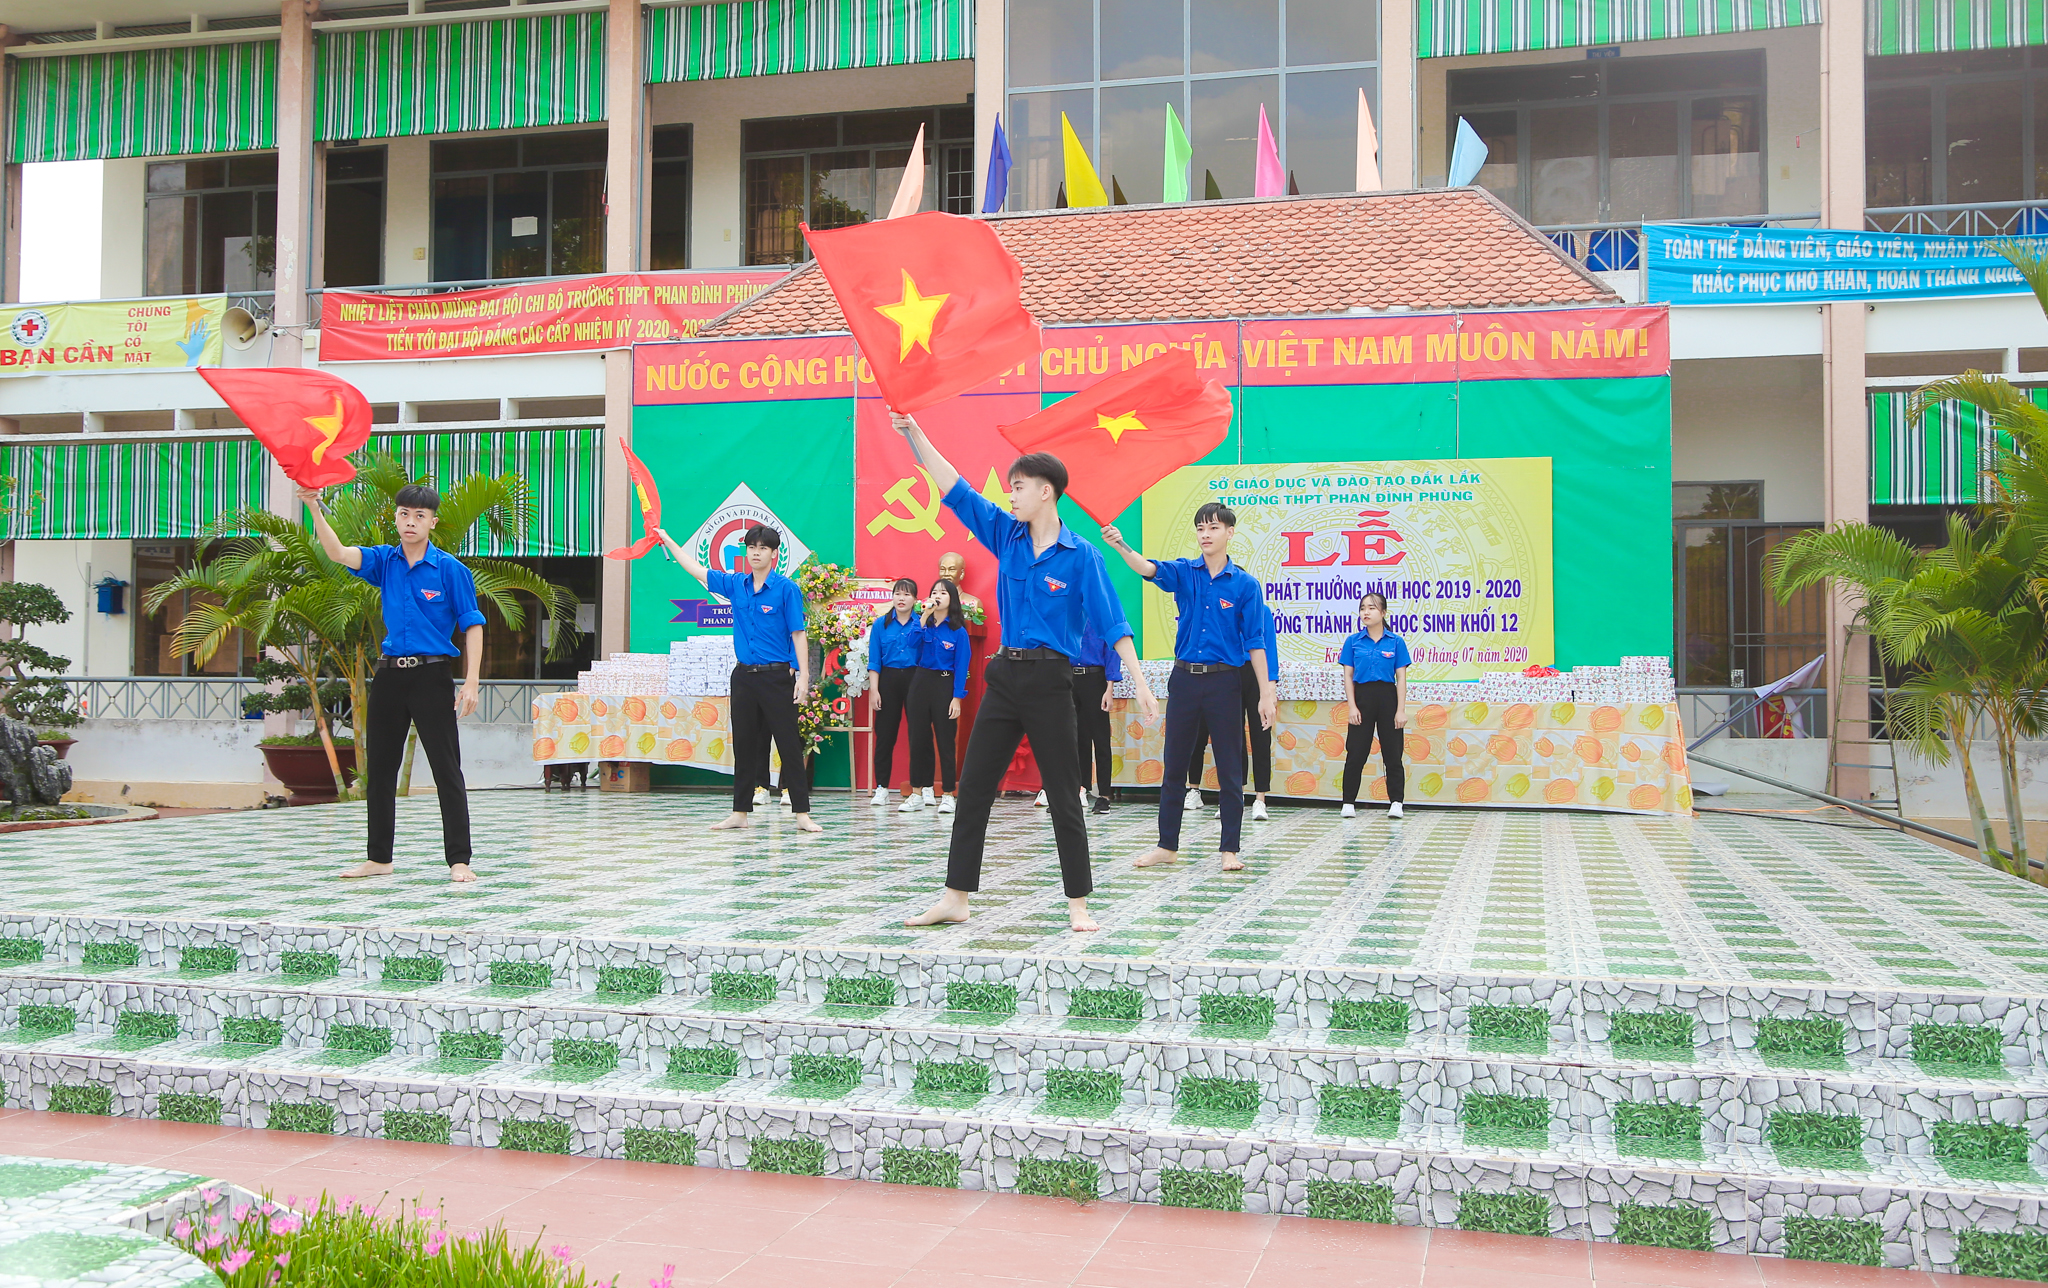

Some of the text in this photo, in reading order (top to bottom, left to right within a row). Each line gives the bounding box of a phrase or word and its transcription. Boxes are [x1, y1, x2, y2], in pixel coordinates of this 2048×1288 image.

[1663, 234, 1703, 260] TOÀN
[1708, 230, 1740, 259] THỂ
[1743, 232, 1786, 259] ĐẢNG
[1790, 235, 1831, 261] VIÊN,
[1836, 235, 1873, 258] GIÁO
[1877, 236, 1918, 261] VIÊN,
[1923, 238, 1968, 258] NHÂN
[1692, 265, 1734, 293] KHẮC
[1739, 273, 1780, 296] PHỤC
[1925, 265, 1980, 287] THÀNH
[1984, 267, 2026, 286] NHIỆ
[128, 305, 171, 318] CHÚNG
[340, 299, 375, 325] NHIỆT
[378, 299, 404, 324] LIỆT
[443, 297, 477, 319] MỪNG
[479, 298, 500, 320] ĐẠI
[502, 292, 523, 318] HỘI
[525, 294, 545, 313] CHI
[547, 287, 564, 313] BỘ
[567, 284, 614, 309] TRƯỜNG
[617, 286, 650, 305] THPT
[654, 285, 688, 305] PHAN
[692, 280, 722, 304] ĐÌNH
[127, 320, 148, 332] TÔI
[386, 326, 413, 351] TIẾN
[416, 327, 436, 350] TỚI
[439, 331, 459, 352] ĐẠI
[461, 326, 483, 351] HỘI
[485, 322, 517, 347] ĐẢNG
[520, 321, 544, 345] CÁC
[547, 317, 571, 343] CẤP
[574, 316, 613, 344] NHIỆM
[616, 314, 633, 338] KỲ
[636, 319, 670, 338] 2020
[0, 339, 114, 369] BẠN CẦN
[125, 335, 141, 348] CÓ
[646, 351, 730, 391] NƯỚC
[739, 354, 827, 395] CỘNG
[1042, 333, 1109, 376] CHỦ
[1242, 329, 1324, 377] VIỆT
[1333, 335, 1412, 366] NAM
[1426, 323, 1536, 363] MUÔN
[1551, 320, 1649, 360] NĂM!
[1209, 470, 1481, 490] SỞ GIÁO DỤC VÀ ĐÀO TẠO ĐẮK LẮK
[1217, 489, 1473, 506] TRƯỜNG THPT PHAN ĐÌNH PHÙNG
[713, 515, 725, 525] GD
[1281, 510, 1407, 567] LỄ
[1266, 578, 1301, 600] PHÁT
[1306, 575, 1362, 600] THƯỞNG
[1366, 578, 1397, 599] NĂM
[1402, 581, 1431, 603] HỌC
[1436, 580, 1471, 599] 2019
[1485, 579, 1521, 599] 2020
[1306, 610, 1352, 633] THÀNH
[1390, 614, 1418, 636] HỌC
[1423, 614, 1455, 633] SINH
[1461, 606, 1495, 632] KHỐI
[1501, 614, 1518, 632] 12
[1413, 649, 1425, 663] 09
[1428, 647, 1459, 666] tháng
[1462, 647, 1474, 663] 07
[1477, 649, 1500, 663] năm
[1504, 647, 1528, 663] 2020
